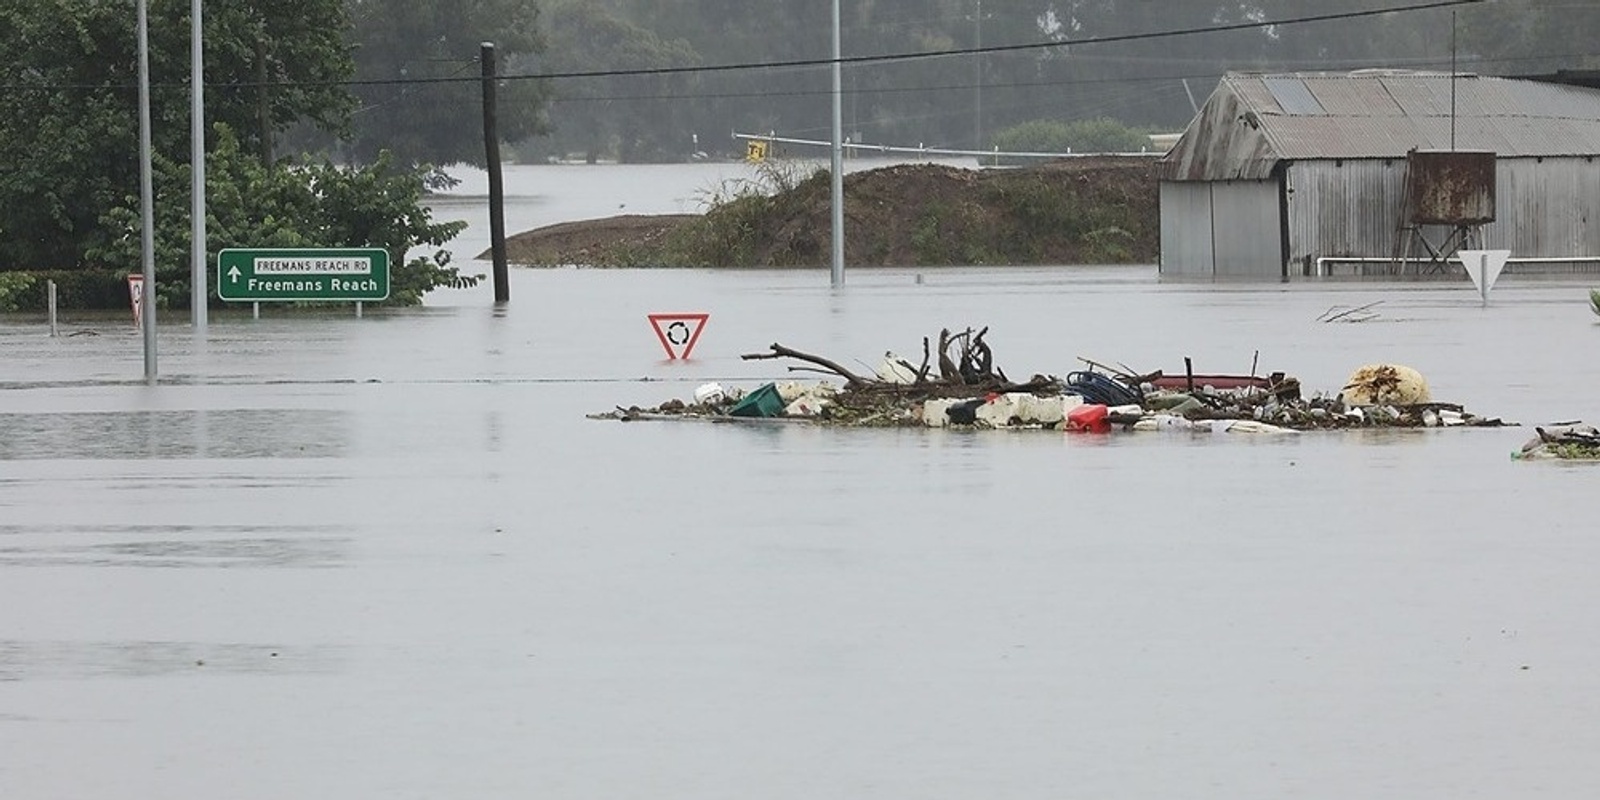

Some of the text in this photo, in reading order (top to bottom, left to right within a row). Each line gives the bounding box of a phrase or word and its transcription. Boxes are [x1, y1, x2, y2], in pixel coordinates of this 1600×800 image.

[257, 260, 368, 272] FREEMANS REACH RD
[248, 278, 378, 291] Freemans Reach
